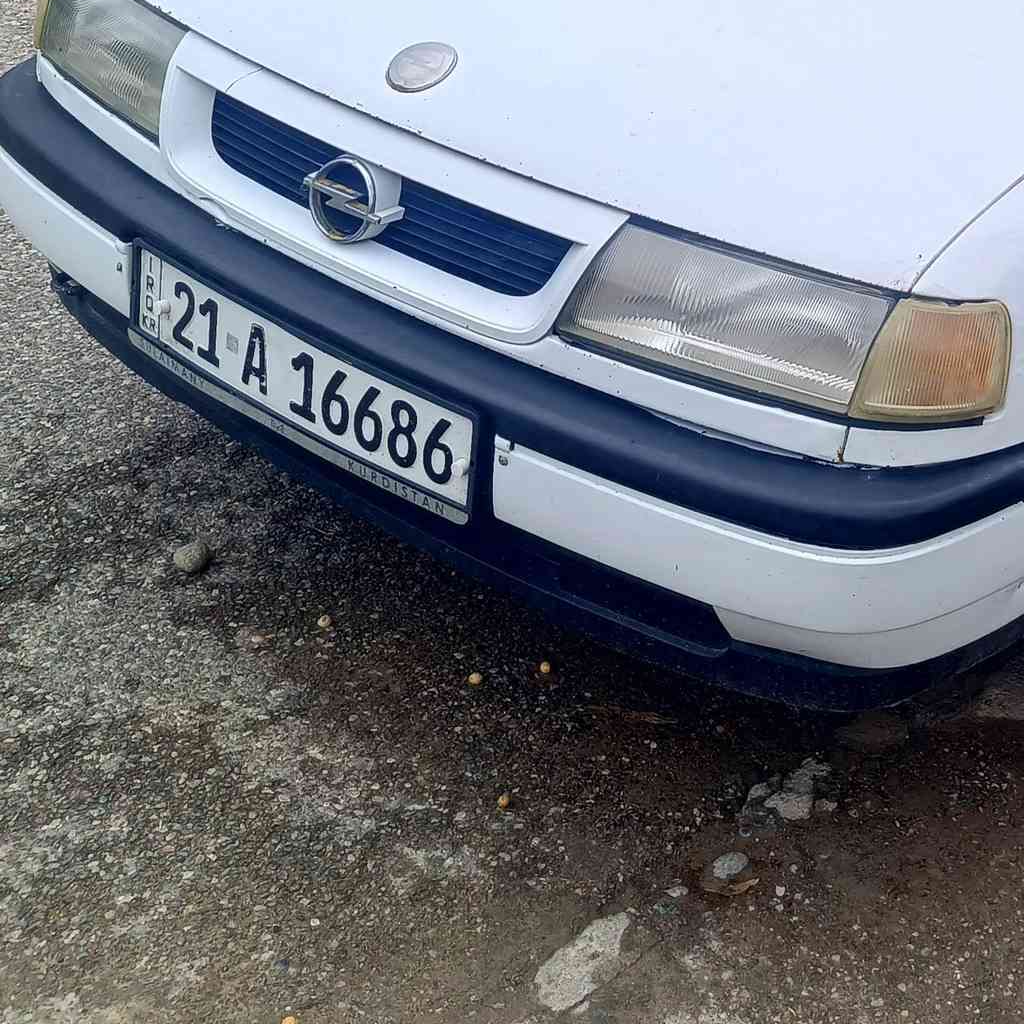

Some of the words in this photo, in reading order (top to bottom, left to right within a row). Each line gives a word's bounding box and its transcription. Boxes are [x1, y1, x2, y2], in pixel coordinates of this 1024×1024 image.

[142, 313, 156, 330] KR
[172, 281, 220, 367] 21
[241, 324, 267, 396] A
[289, 352, 453, 484] 16686
[347, 458, 445, 515] KURDISTAN
